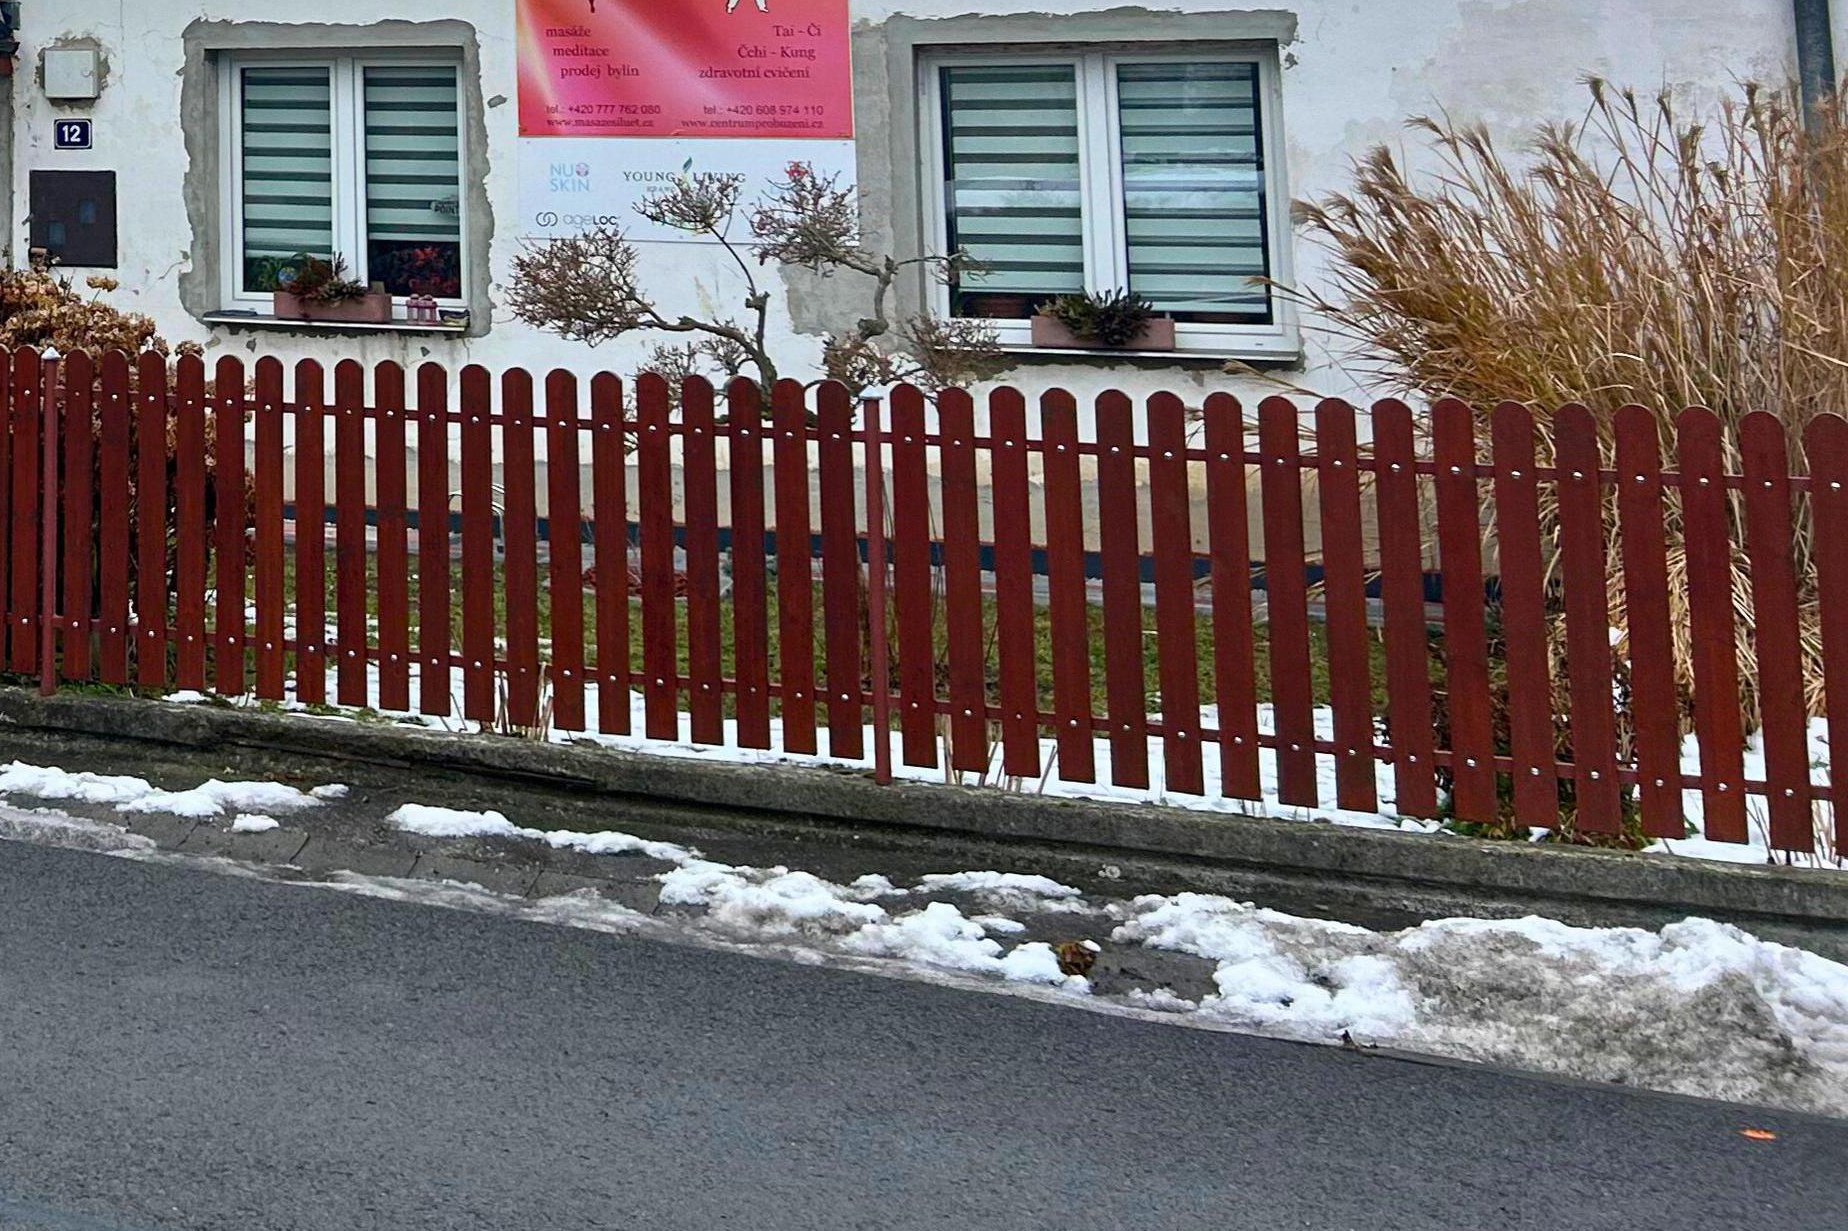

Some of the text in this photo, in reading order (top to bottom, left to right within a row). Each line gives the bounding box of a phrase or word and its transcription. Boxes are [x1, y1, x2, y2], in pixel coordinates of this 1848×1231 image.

[772, 24, 795, 37] Tai
[552, 44, 610, 57] meditace
[780, 45, 817, 61] Kung
[560, 64, 602, 79] prodej
[596, 104, 616, 115] 777
[62, 125, 81, 143] 12
[623, 170, 675, 183] YOUNG
[550, 178, 591, 193] SKIN
